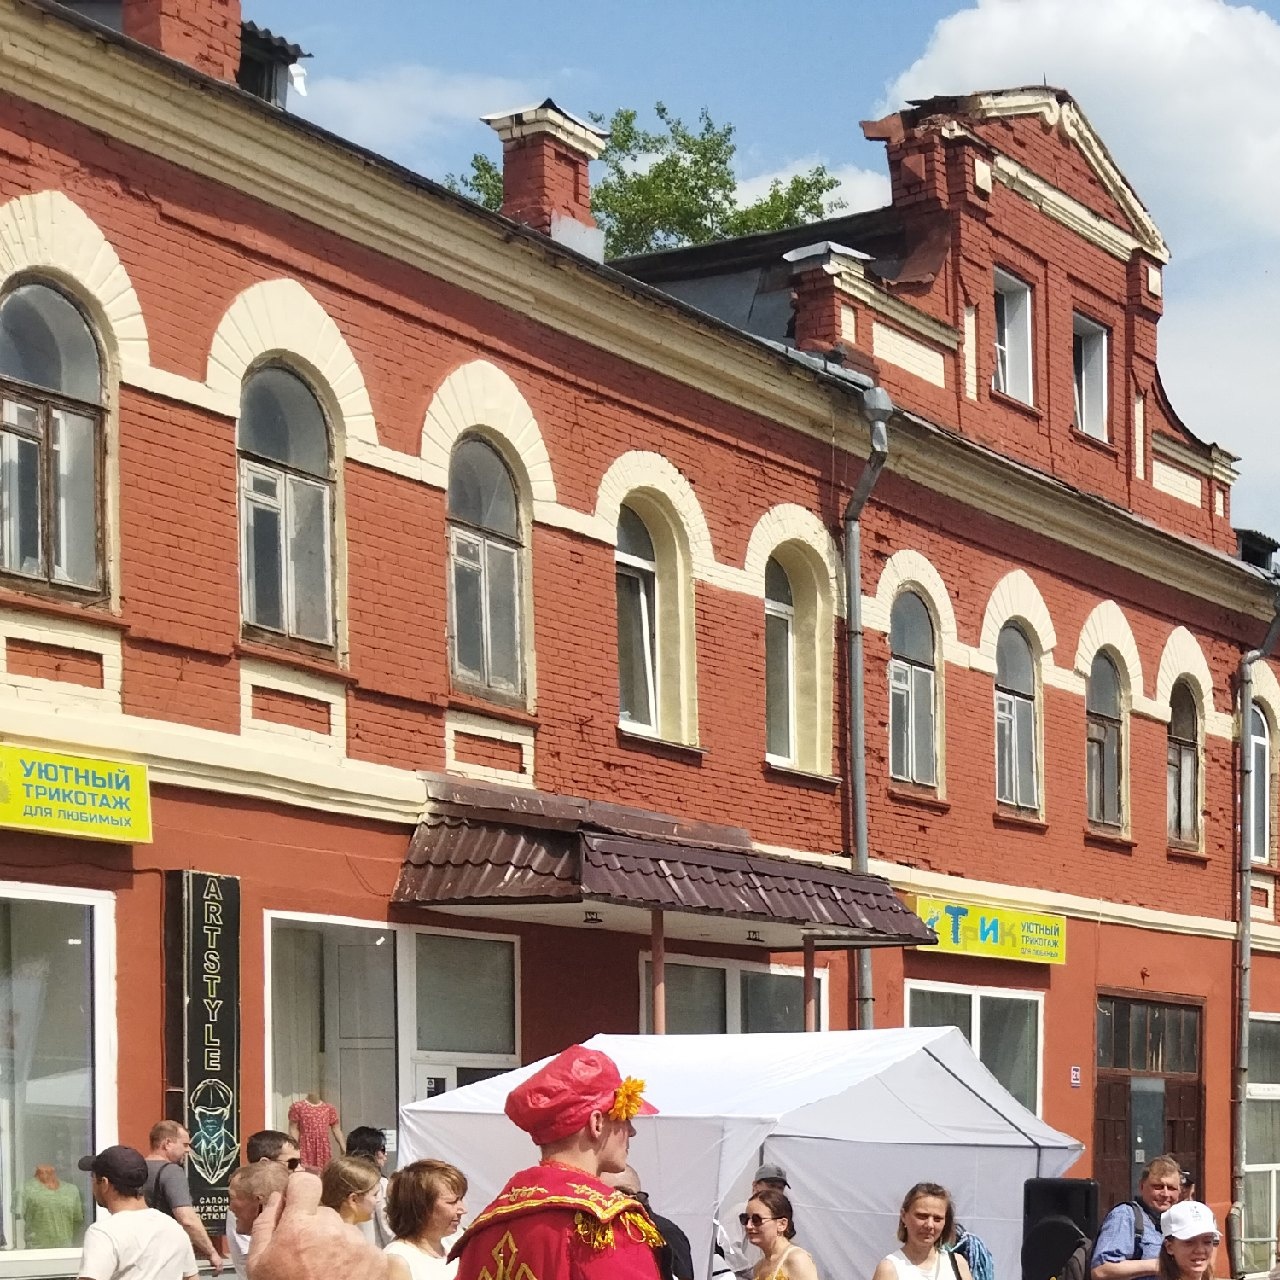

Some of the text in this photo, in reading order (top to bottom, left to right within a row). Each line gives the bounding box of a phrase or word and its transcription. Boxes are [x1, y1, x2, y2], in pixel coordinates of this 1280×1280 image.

[20, 759, 131, 791] УЮТНЫЙ
[22, 783, 131, 811] ТРИКОТАЖ
[23, 805, 132, 827] ДЛЯ ЛЮБИМЫХ
[1021, 921, 1060, 937] УЮТНЫЙ
[1021, 935, 1059, 948] ТРИКОТАЖ
[203, 877, 223, 1071] ARTSTYLE
[200, 1196, 229, 1204] САЛОН
